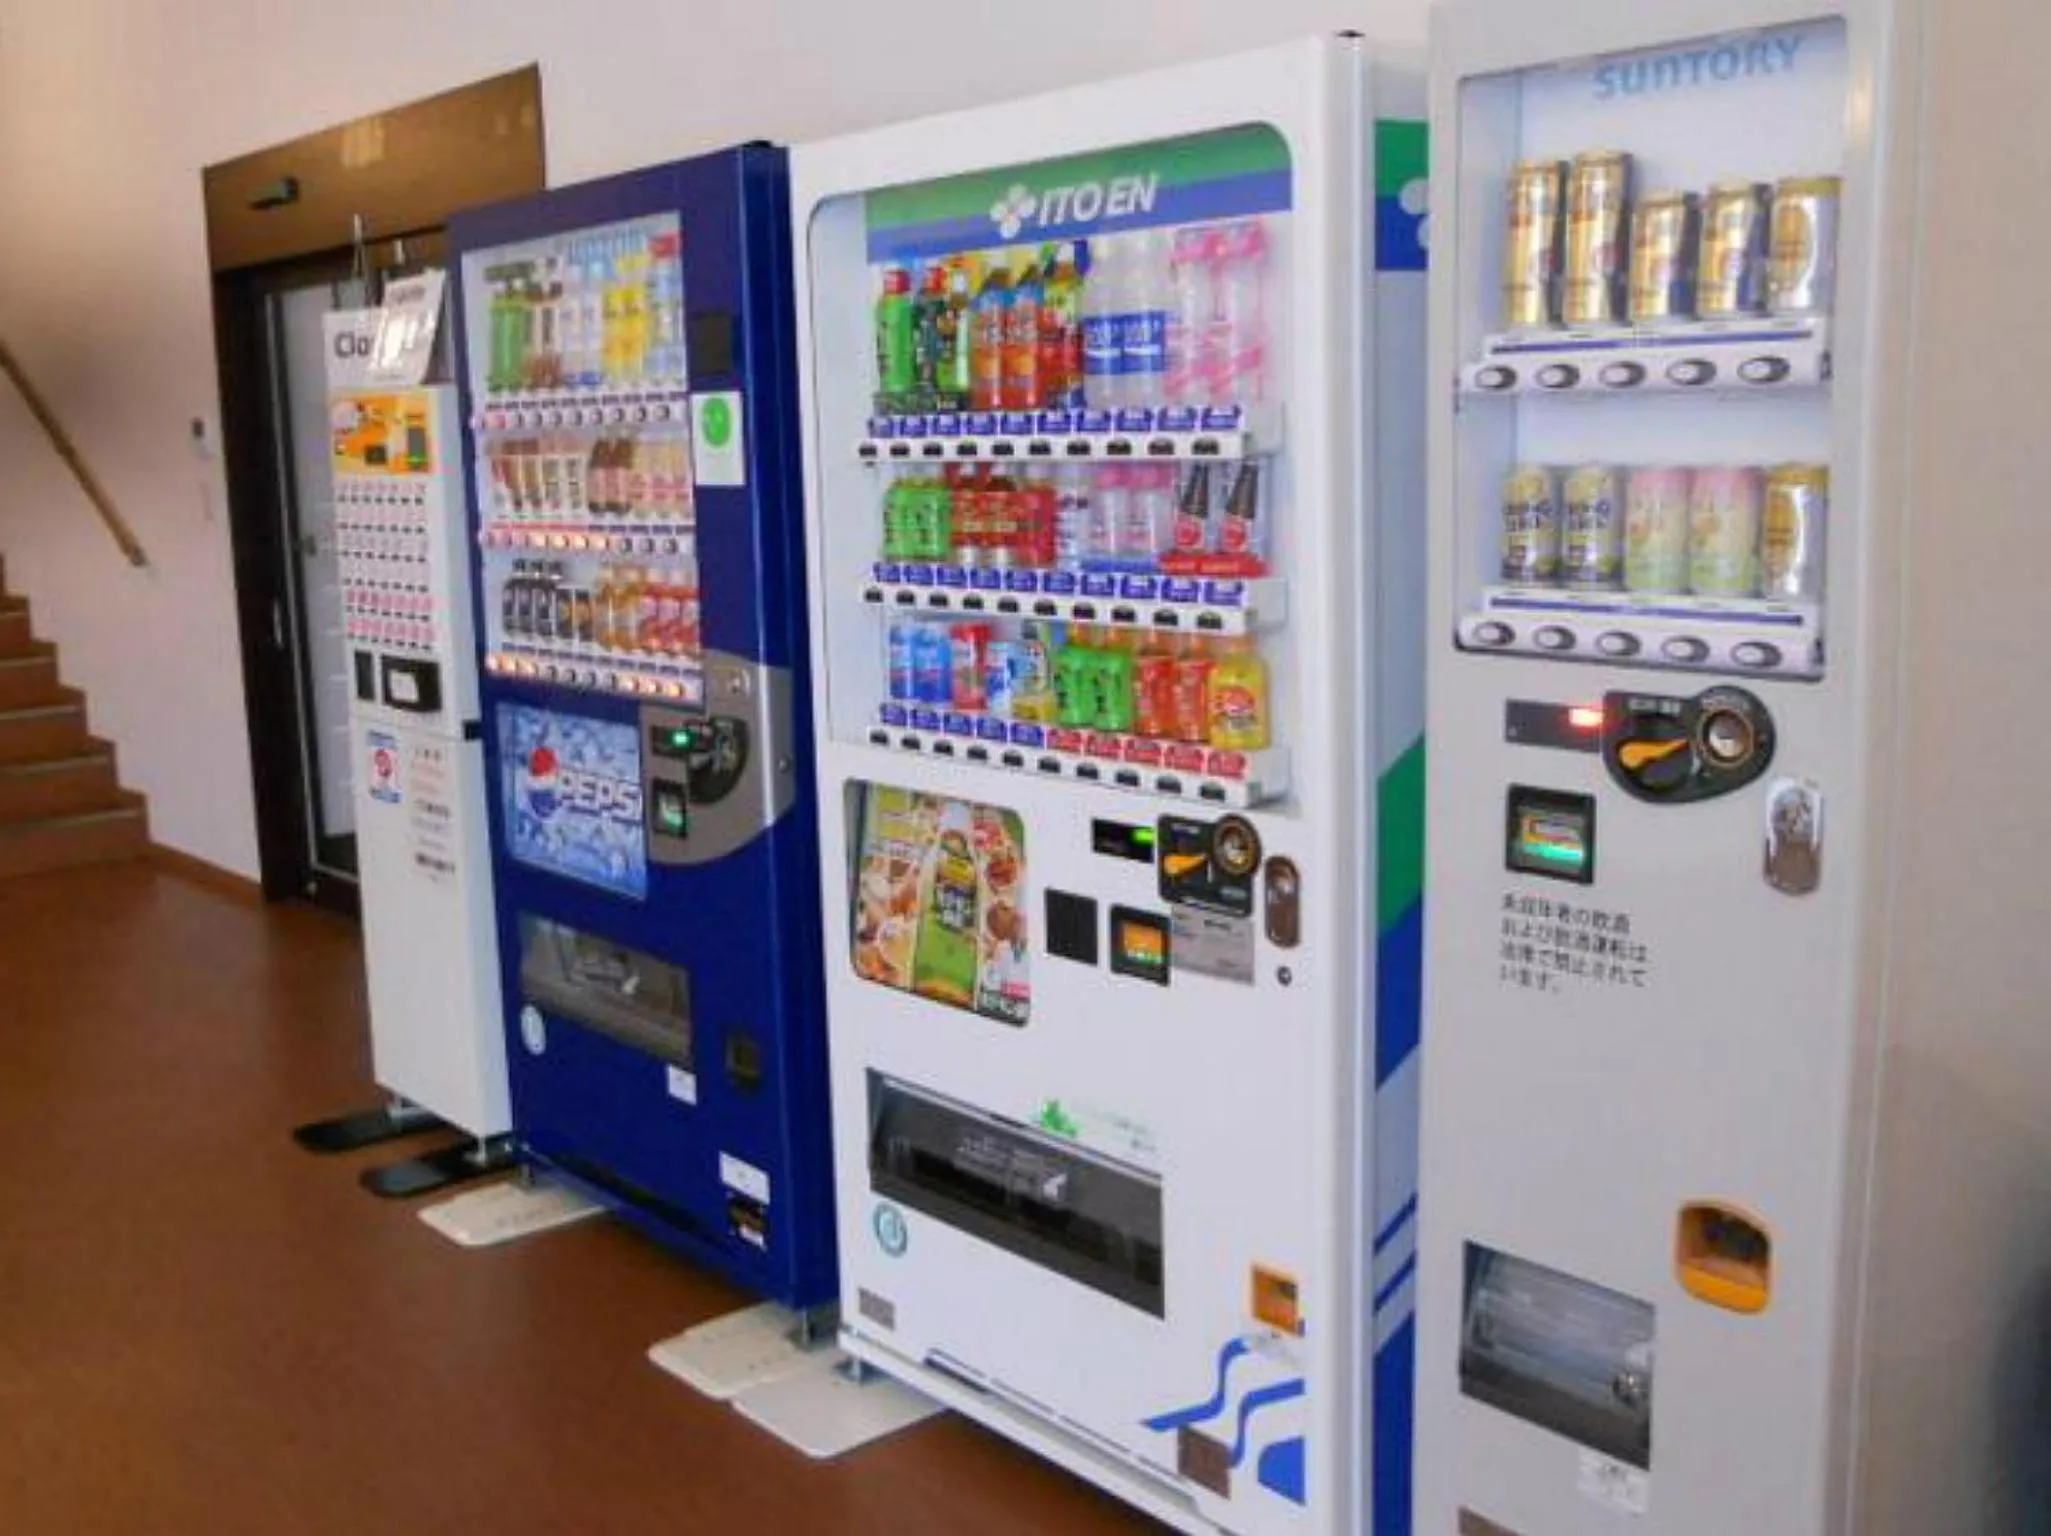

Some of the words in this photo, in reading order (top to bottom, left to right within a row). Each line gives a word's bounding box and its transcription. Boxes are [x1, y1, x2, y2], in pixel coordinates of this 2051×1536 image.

[1037, 180, 1102, 227] ITO
[1104, 172, 1160, 217] EN
[333, 330, 374, 359] Clo
